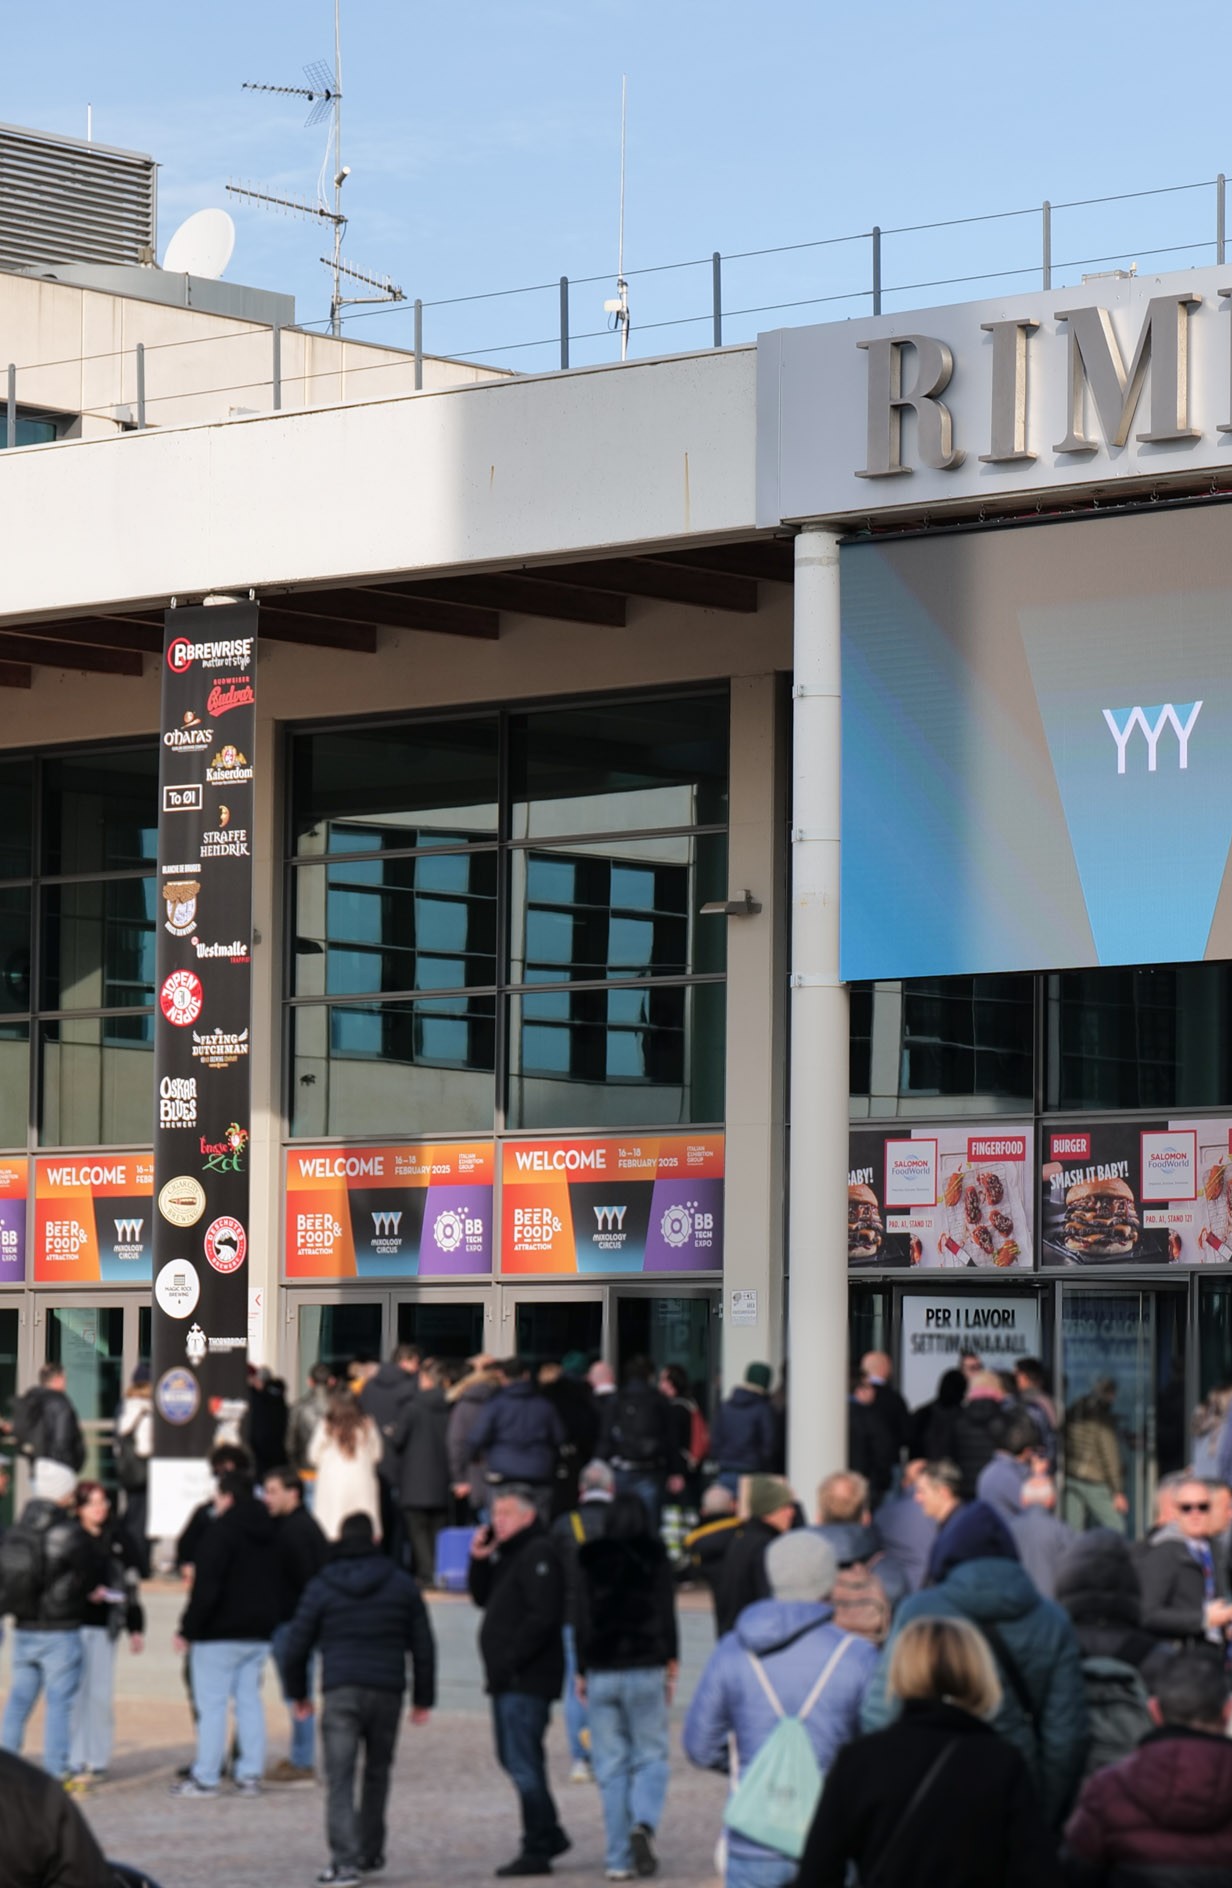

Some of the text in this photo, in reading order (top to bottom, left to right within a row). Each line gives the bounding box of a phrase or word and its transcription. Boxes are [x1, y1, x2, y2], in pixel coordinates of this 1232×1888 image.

[225, 655, 232, 667] of
[233, 653, 250, 671] style
[206, 766, 253, 781] Kaiserdom
[169, 791, 182, 805] To
[203, 829, 247, 843] STRAFFE
[200, 840, 250, 857] HENDRIK
[196, 941, 247, 958] Westmalle
[162, 971, 199, 1000] JOPEN
[200, 1034, 238, 1046] FLYING
[192, 1044, 248, 1056] DUTCHMAN
[160, 1076, 197, 1100] OSKAR
[160, 1099, 197, 1121] BLUES
[971, 1141, 1023, 1155] FINGERFOOD
[1053, 1138, 1087, 1153] BURGER
[202, 1153, 246, 1173] Zot
[515, 1148, 607, 1171] WELCOME
[618, 1157, 679, 1169] FEBRUARY 2025
[1148, 1159, 1190, 1168] FoodWorld
[1151, 1152, 1187, 1160] SALOMON
[299, 1157, 385, 1177] WELCOME
[395, 1164, 451, 1175] FEBRUARY 2025
[891, 1167, 930, 1175] FoodWorld
[46, 1166, 127, 1186] WELCOME
[1050, 1160, 1129, 1190] SMASH IT BABY!
[297, 1214, 342, 1237] BEER &
[514, 1208, 562, 1232] BEER &
[694, 1213, 714, 1230] BB
[909, 1220, 924, 1228] STAND
[1145, 1215, 1158, 1223] PAD.
[1167, 1214, 1184, 1223] STAND
[45, 1221, 88, 1244] BEER &
[207, 1218, 244, 1241] DESCHUTES
[465, 1218, 483, 1235] BB
[514, 1225, 553, 1243] FOOD
[1, 1230, 18, 1246] BB
[297, 1231, 334, 1247] FOOD
[370, 1238, 402, 1246] MIXOLOGY
[465, 1236, 483, 1244] TECH
[592, 1233, 627, 1241] MIXOLOGY
[694, 1231, 713, 1239] TECH
[45, 1238, 80, 1253] FOOD
[297, 1247, 334, 1255] ATTRACTION
[376, 1246, 398, 1254] CIRCUS
[465, 1244, 483, 1252] EXPO
[514, 1243, 552, 1251] ATTRACTION
[598, 1241, 622, 1249] CIRCUS
[694, 1239, 713, 1248] EXPO
[926, 1308, 951, 1329] PER
[965, 1308, 1015, 1329] LAVORI
